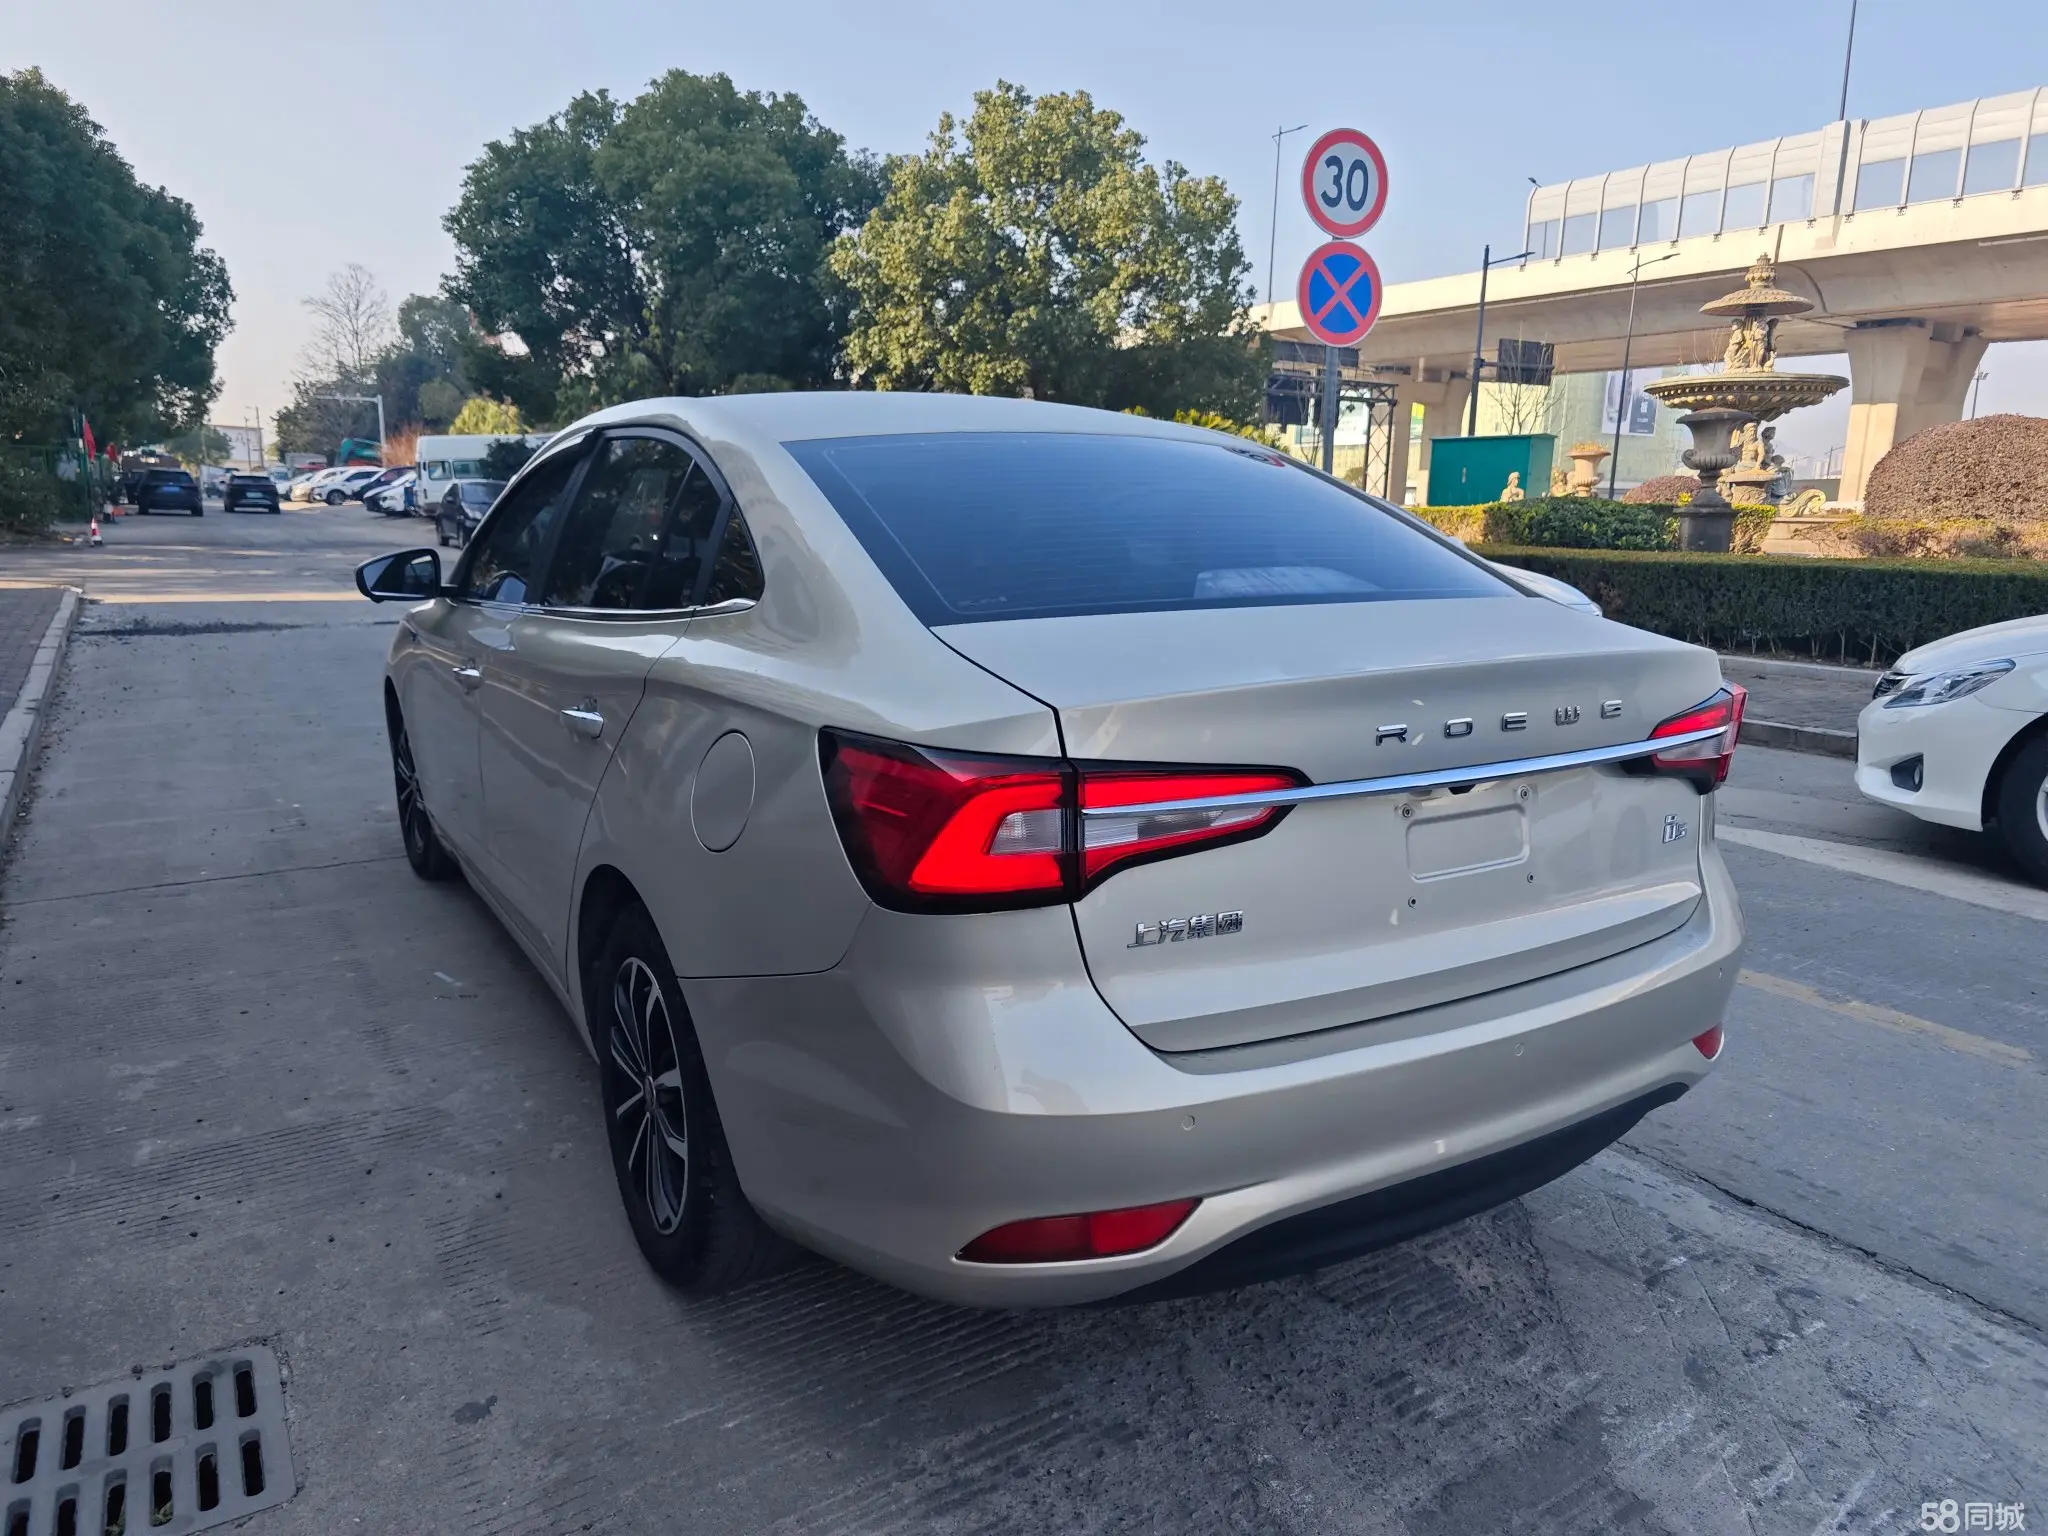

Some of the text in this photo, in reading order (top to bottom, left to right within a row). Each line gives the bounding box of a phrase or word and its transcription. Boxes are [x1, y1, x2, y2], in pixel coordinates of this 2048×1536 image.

[1320, 155, 1369, 211] 30
[1375, 699, 1623, 746] ROEWE
[1126, 909, 1245, 949] 上汽集团
